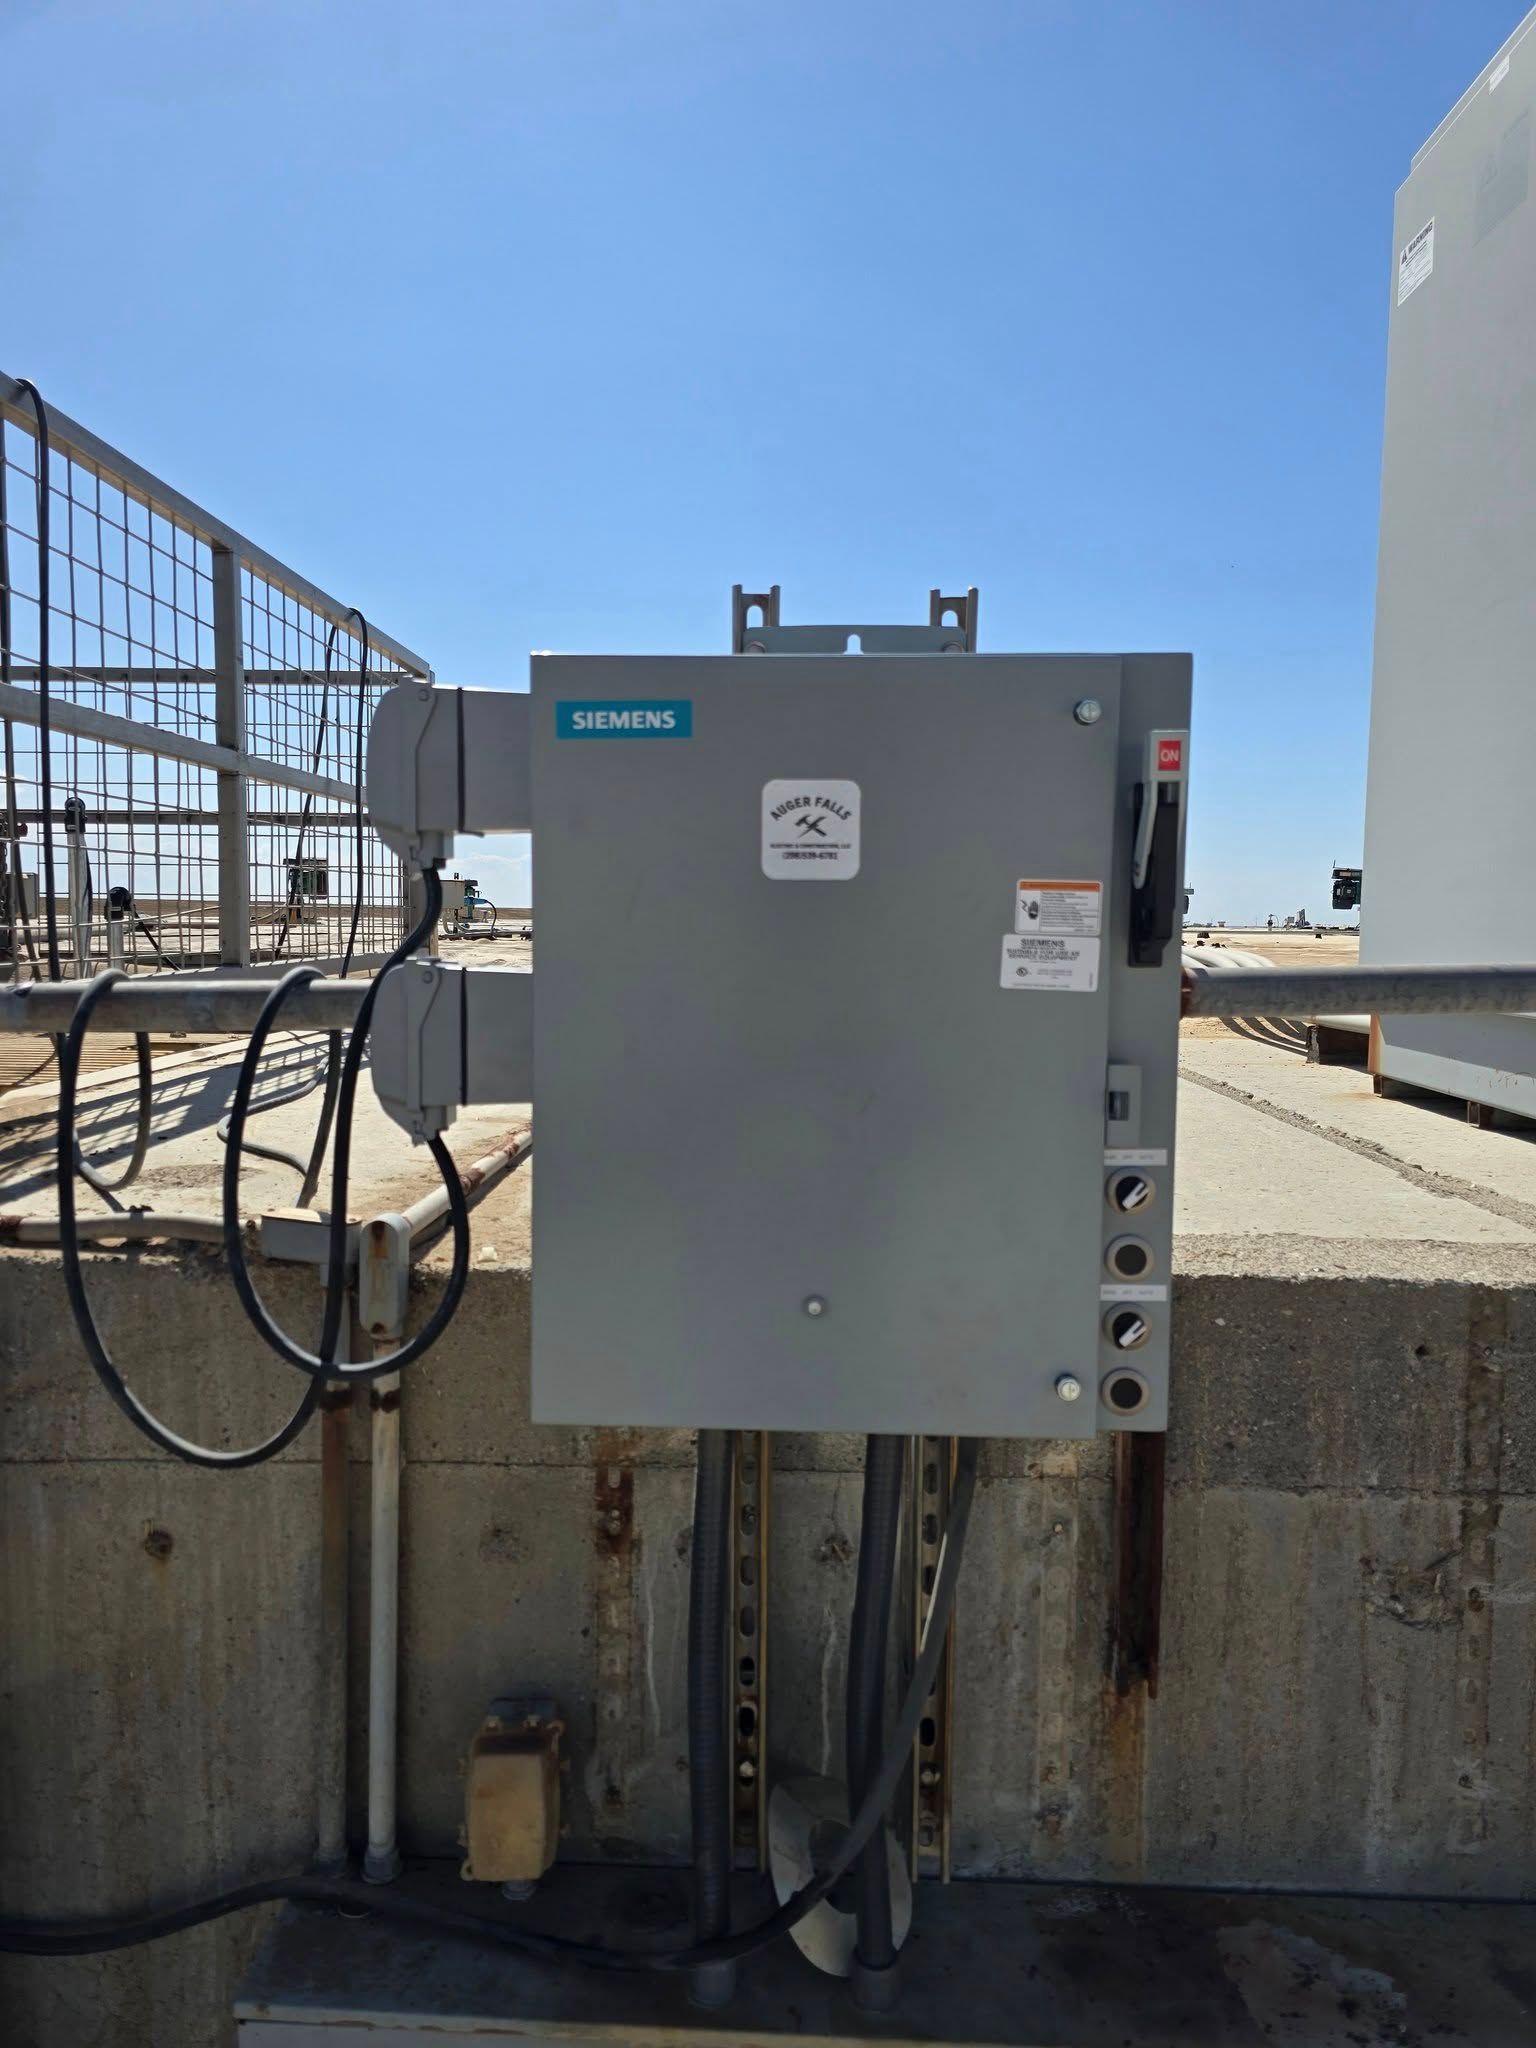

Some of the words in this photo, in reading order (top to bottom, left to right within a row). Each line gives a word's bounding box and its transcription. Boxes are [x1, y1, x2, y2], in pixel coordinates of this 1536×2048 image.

[572, 710, 676, 730] SIEMENS
[1160, 749, 1180, 762] ON
[770, 797, 811, 821] AUGER
[815, 797, 852, 821] FALLS
[1021, 938, 1065, 948] SIEMENS
